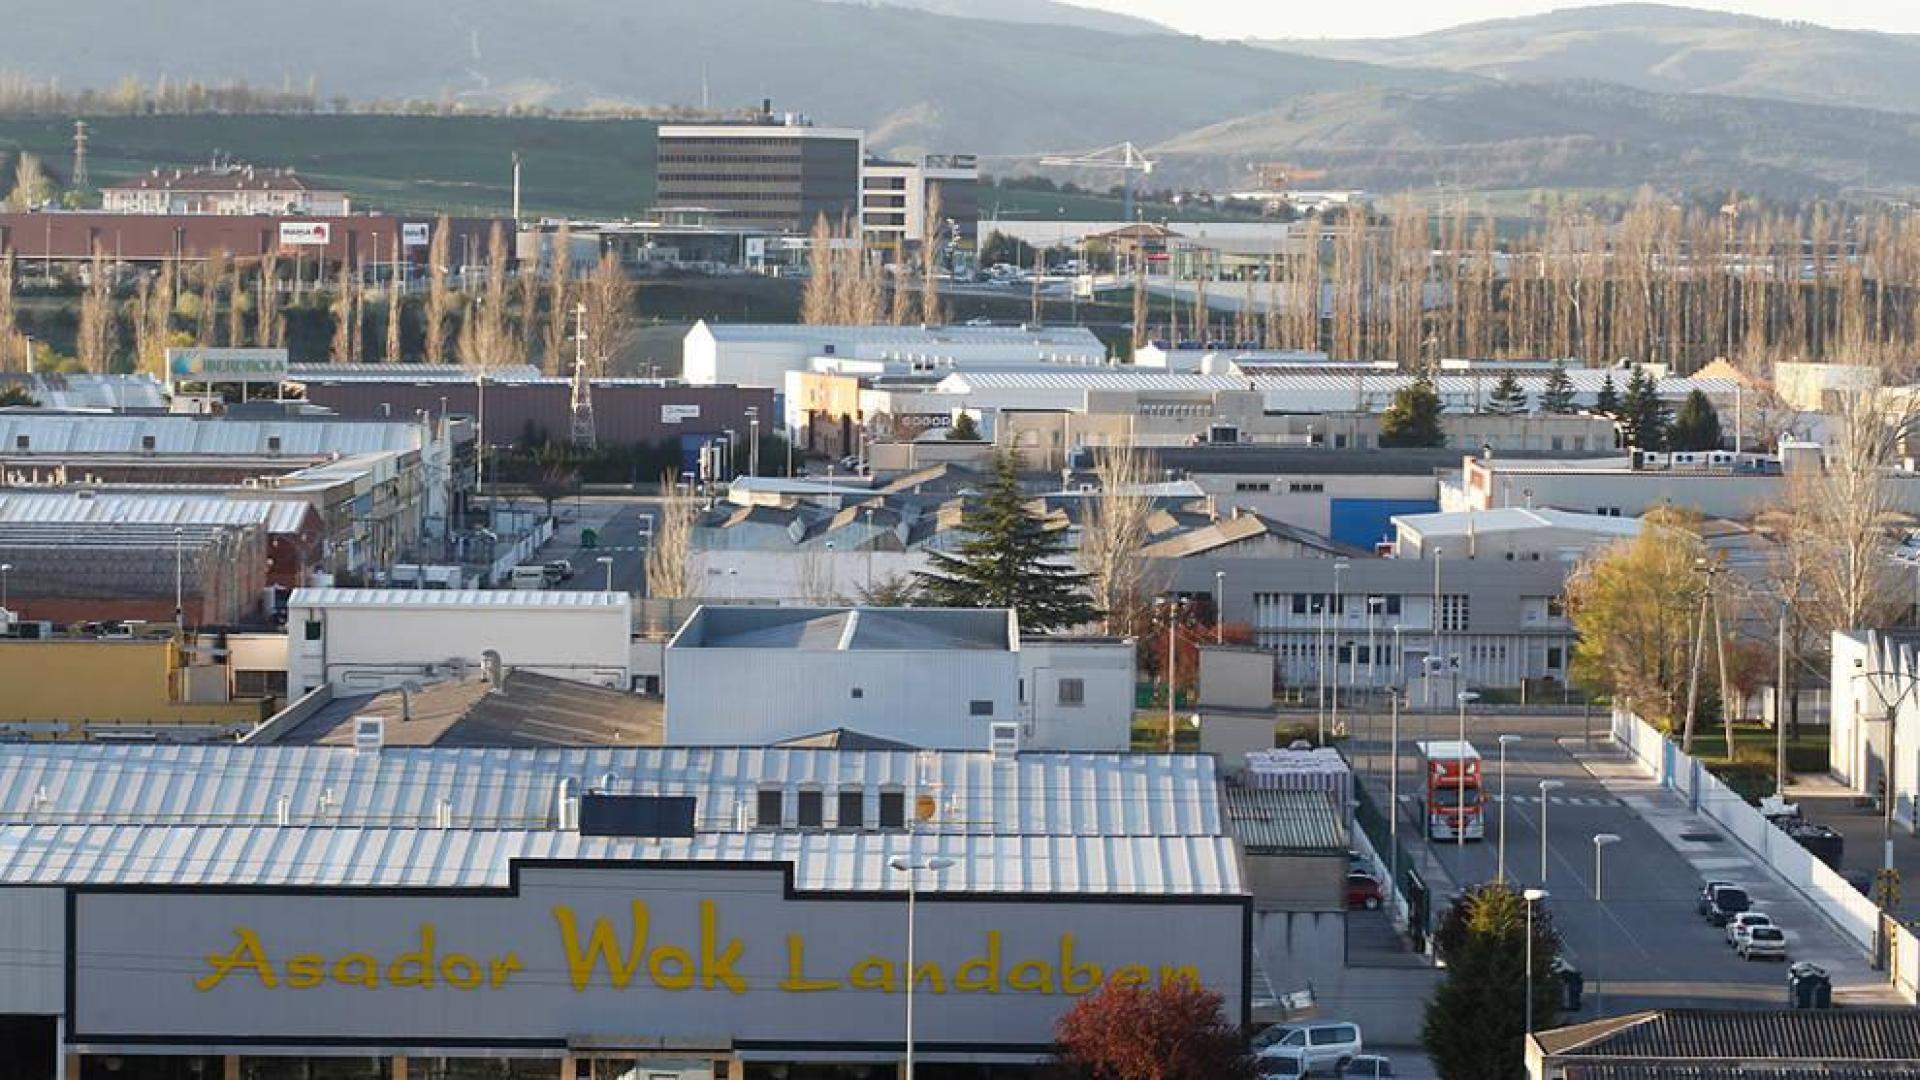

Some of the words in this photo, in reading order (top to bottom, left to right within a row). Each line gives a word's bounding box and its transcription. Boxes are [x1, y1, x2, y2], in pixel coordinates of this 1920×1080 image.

[203, 359, 285, 373] IBERDROLA
[196, 925, 521, 990] Asador
[554, 900, 746, 993] Wok
[780, 931, 1201, 993] Landaben
